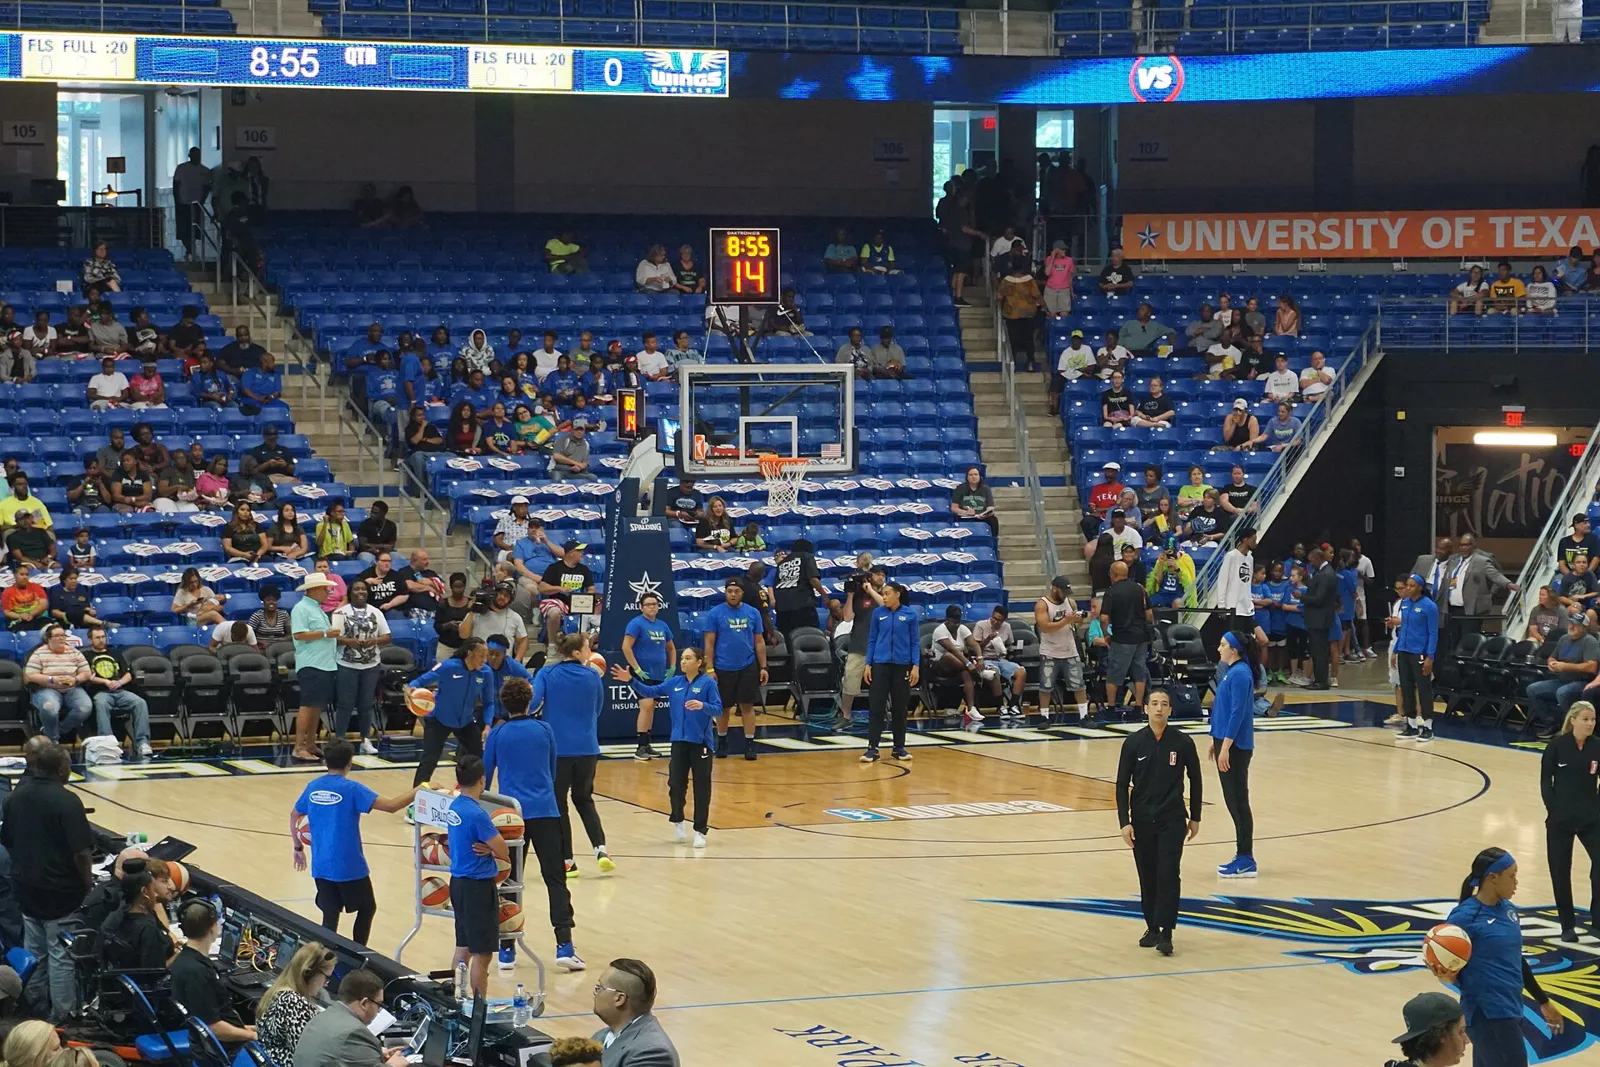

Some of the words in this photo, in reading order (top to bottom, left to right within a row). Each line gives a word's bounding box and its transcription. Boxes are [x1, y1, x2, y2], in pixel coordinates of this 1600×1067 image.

[28, 39, 54, 52] FLS
[63, 40, 97, 53] FULL
[105, 41, 128, 54] :20
[250, 46, 320, 78] 8:55
[474, 51, 498, 64] FLS
[506, 52, 537, 65] FULL
[545, 53, 566, 66] :20
[603, 58, 623, 87] 0
[1137, 64, 1174, 90] VS
[12, 125, 37, 138] 105
[243, 130, 268, 143] 106
[1138, 142, 1160, 155] 107
[1166, 217, 1408, 253] UNIVERSITY
[1421, 216, 1476, 250] OF
[1488, 214, 1600, 249] TEXA
[727, 235, 770, 257] 8:55
[735, 260, 765, 293] 14
[1505, 412, 1522, 426] EXIT
[1097, 493, 1117, 502] TEXA
[630, 523, 662, 531] SPALDING
